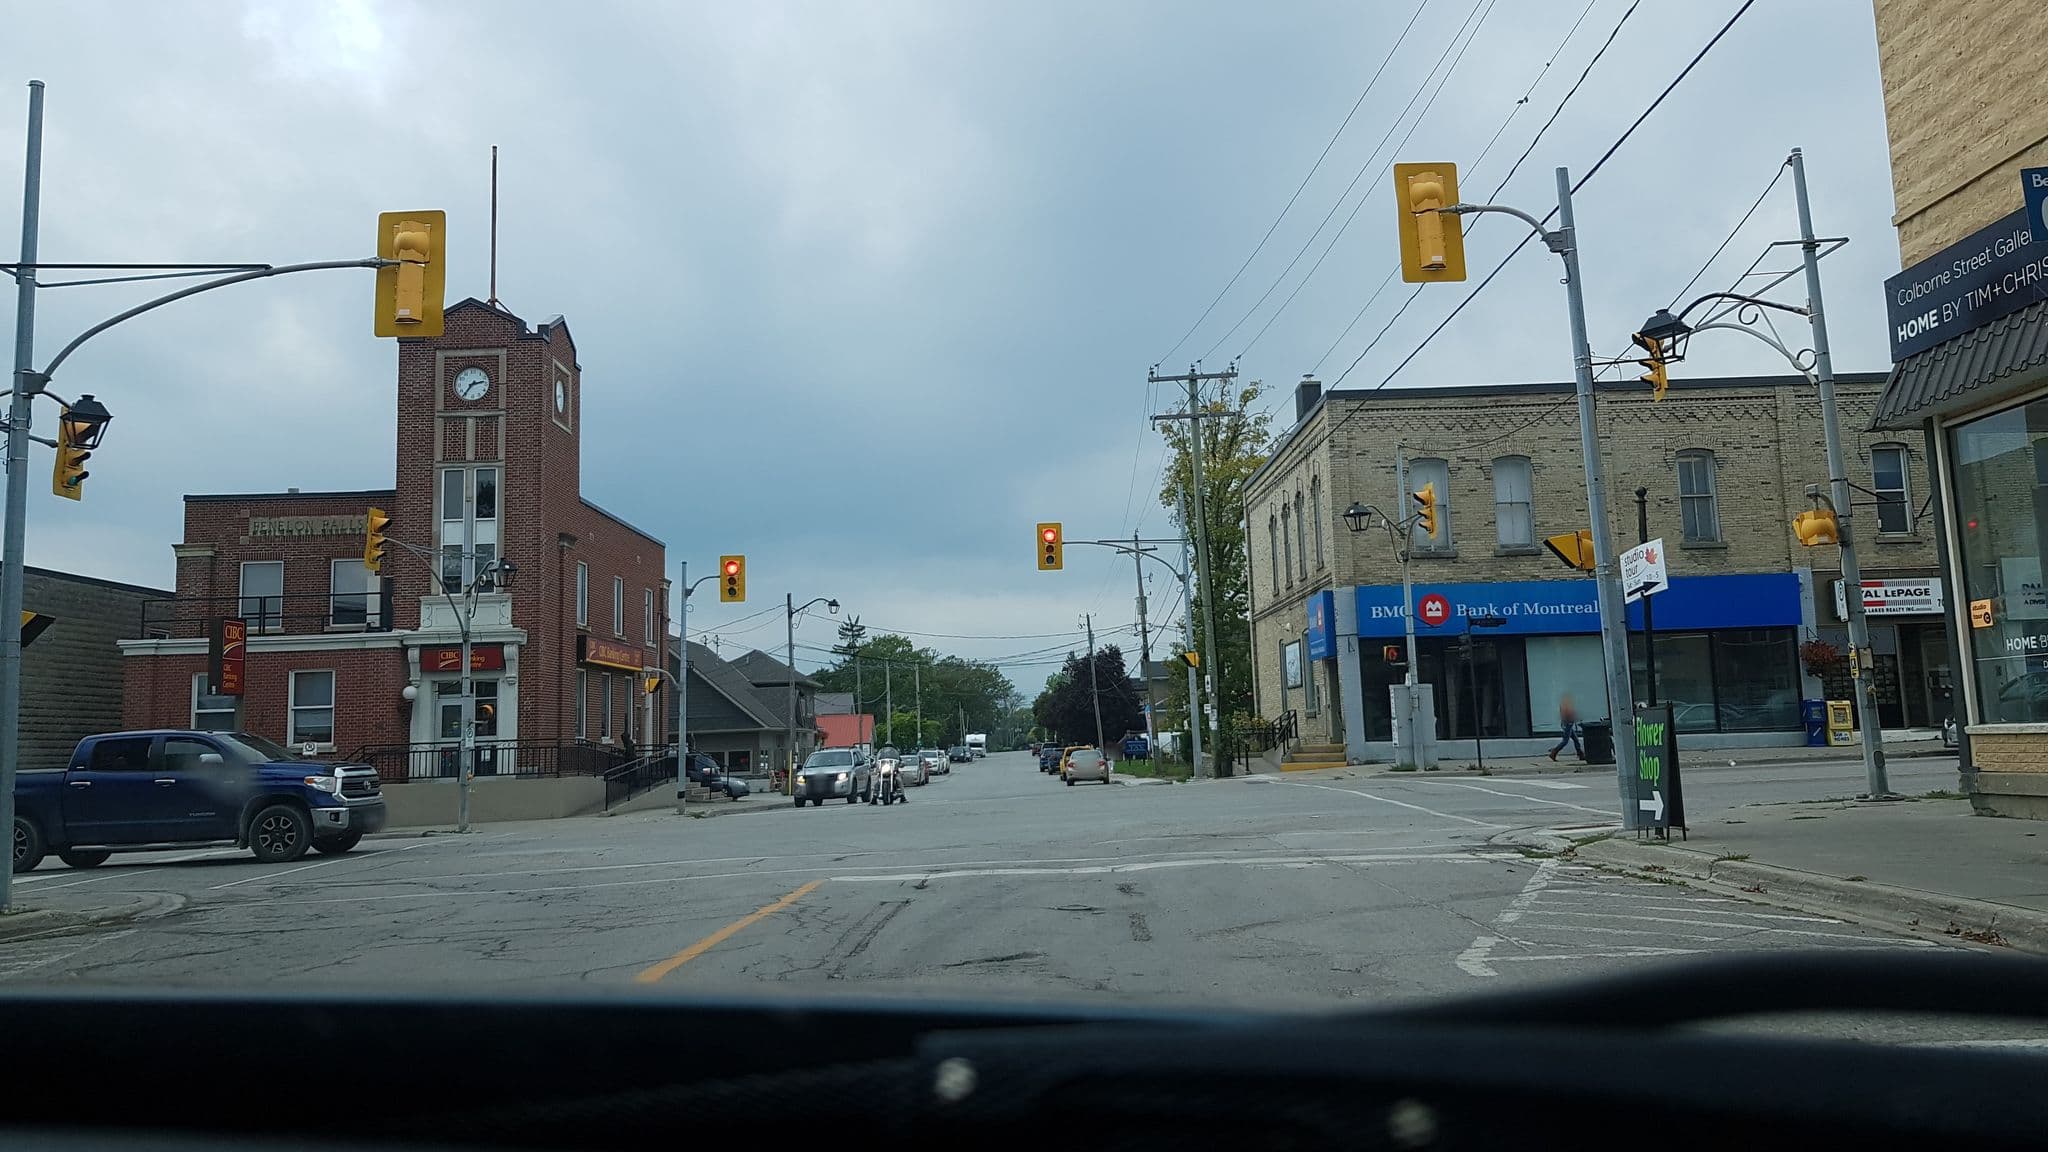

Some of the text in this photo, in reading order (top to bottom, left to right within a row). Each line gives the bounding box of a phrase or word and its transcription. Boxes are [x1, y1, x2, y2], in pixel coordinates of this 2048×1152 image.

[1897, 270, 1951, 306] Colborne
[1953, 247, 1992, 279] Street
[1897, 309, 1939, 343] HOME
[1942, 298, 1961, 323] BY
[1624, 548, 1645, 567] studio
[1625, 564, 1638, 579] tour
[1456, 601, 1599, 617] Bank of Montreal
[225, 625, 243, 640] CIBC
[2006, 636, 2038, 651] HOME
[440, 651, 459, 659] CIBC
[1639, 749, 1660, 787] Shop
